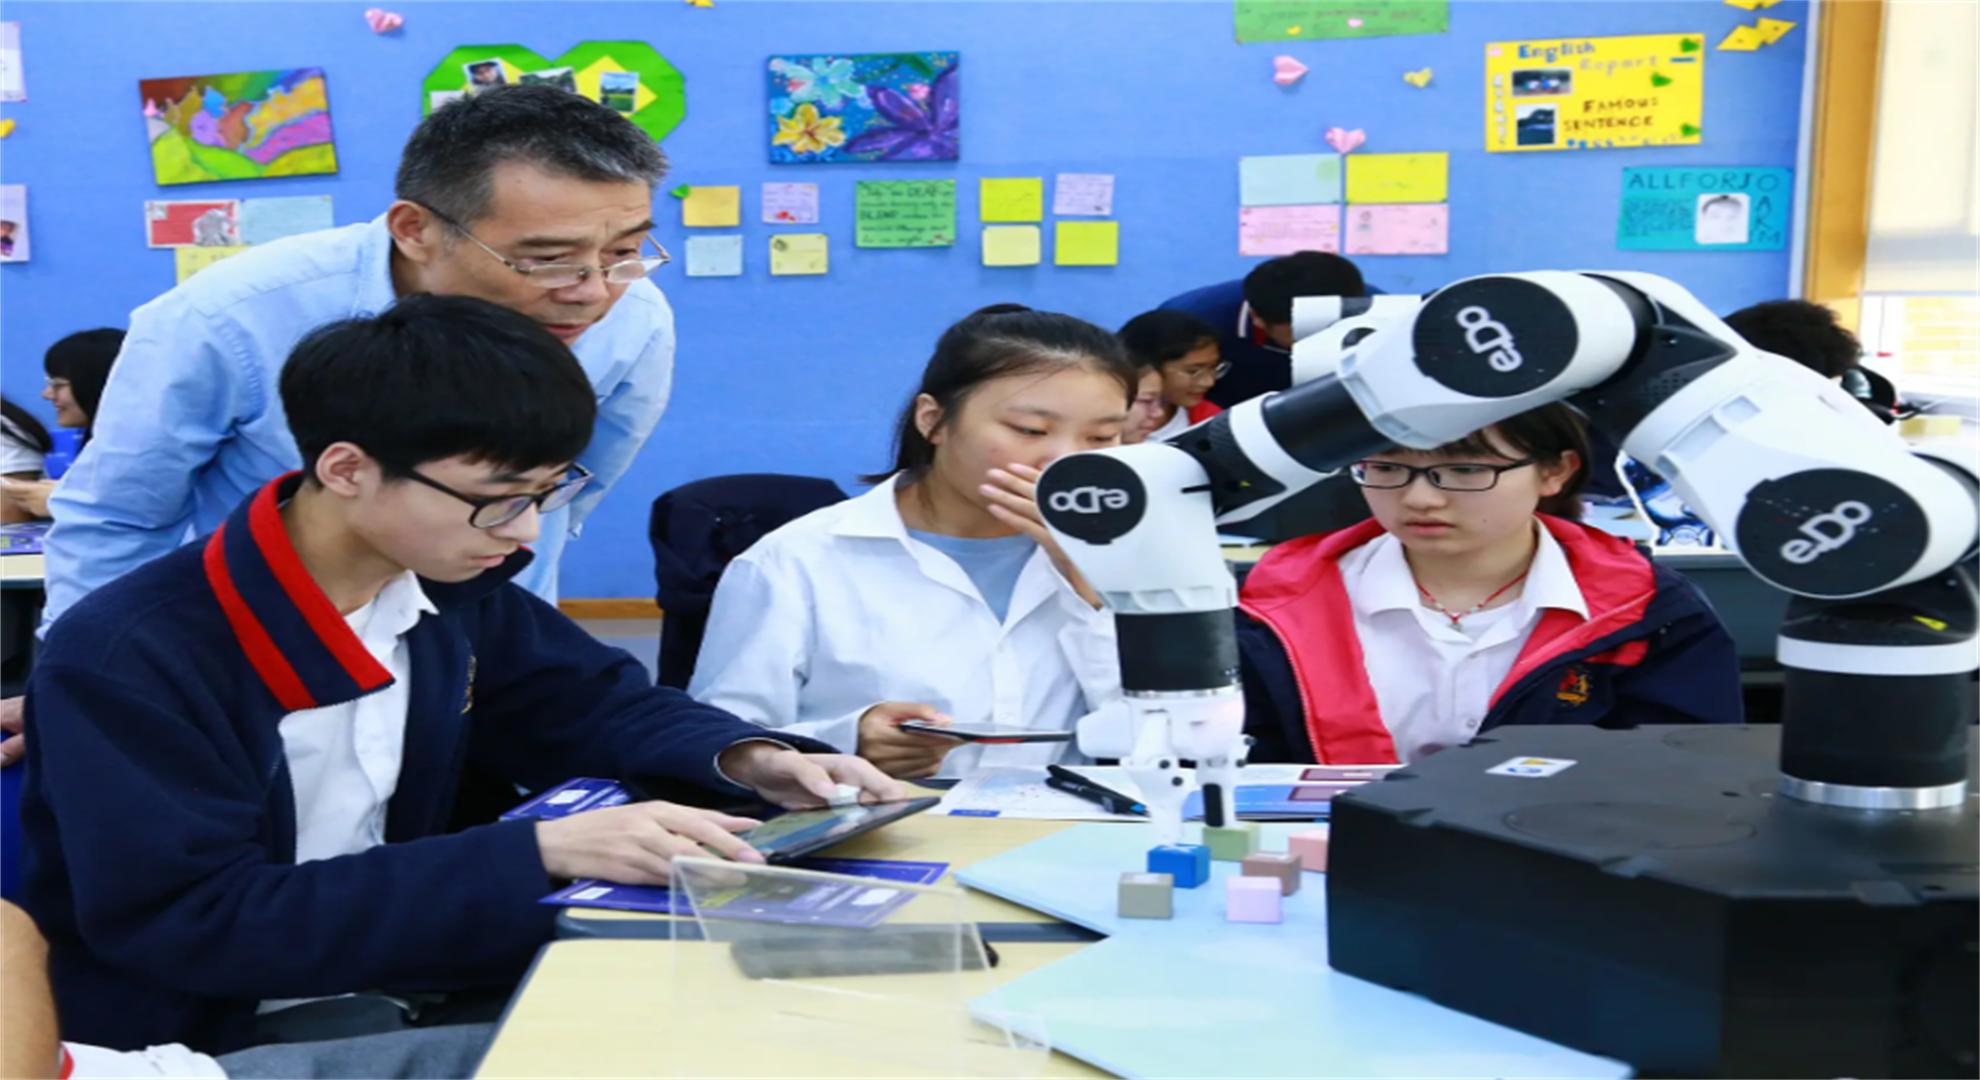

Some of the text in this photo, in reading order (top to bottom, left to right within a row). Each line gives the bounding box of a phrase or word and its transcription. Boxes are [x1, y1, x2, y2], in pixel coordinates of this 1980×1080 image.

[1517, 42, 1595, 63] English
[1583, 96, 1659, 113] FAMOUS
[1563, 115, 1654, 132] SENTENCE
